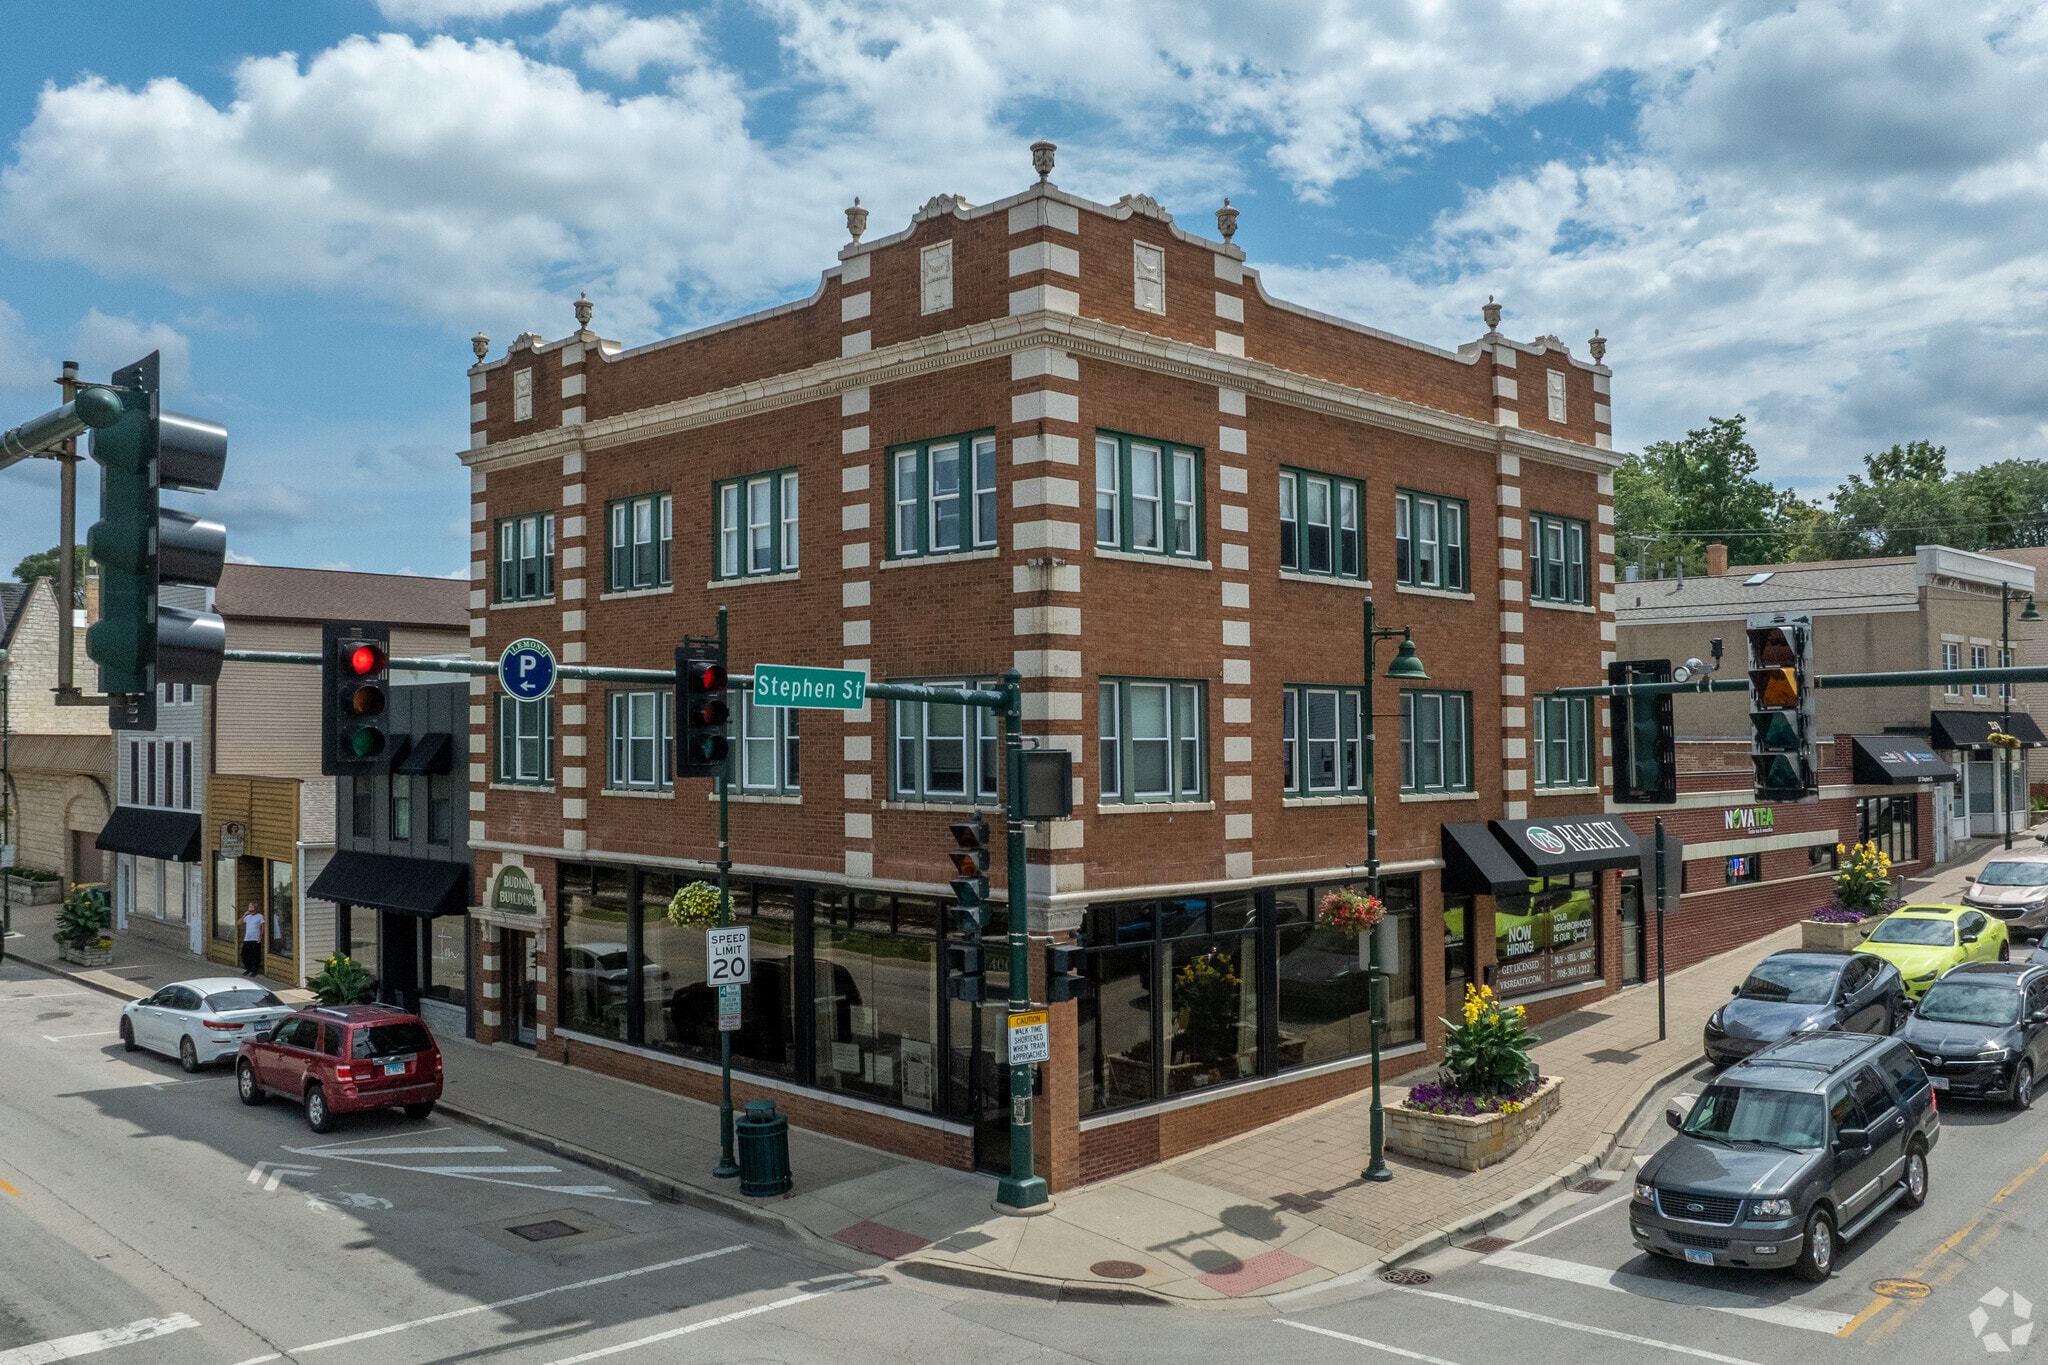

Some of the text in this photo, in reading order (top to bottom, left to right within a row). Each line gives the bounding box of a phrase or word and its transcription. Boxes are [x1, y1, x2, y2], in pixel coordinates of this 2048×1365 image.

[511, 640, 547, 654] LEMONT
[520, 655, 537, 678] P
[758, 675, 862, 702] Stephen St
[1529, 821, 1631, 852] VRS REALTY
[1728, 857, 1750, 877] OPEN
[500, 890, 537, 907] BUILDING
[1553, 912, 1568, 922] YOUR
[1553, 918, 1592, 932] NEIGHBORHOOD
[711, 933, 746, 944] SPEED
[1508, 925, 1532, 942] NOW
[1553, 934, 1559, 942] IS
[1560, 932, 1571, 941] OUR
[716, 945, 742, 956] LIMIT
[1506, 940, 1534, 956] HIRING!
[713, 956, 746, 979] 20
[1501, 960, 1539, 975] GET LICENSED
[1499, 975, 1542, 990] VRSREALTY.COM
[1016, 1015, 1041, 1025] CAUTION
[1015, 1025, 1042, 1035] WALK TIME
[1014, 1033, 1044, 1044] SHORTENED
[1012, 1041, 1046, 1053] WHEN TRAIN
[1012, 1049, 1047, 1062] APPROACHES
